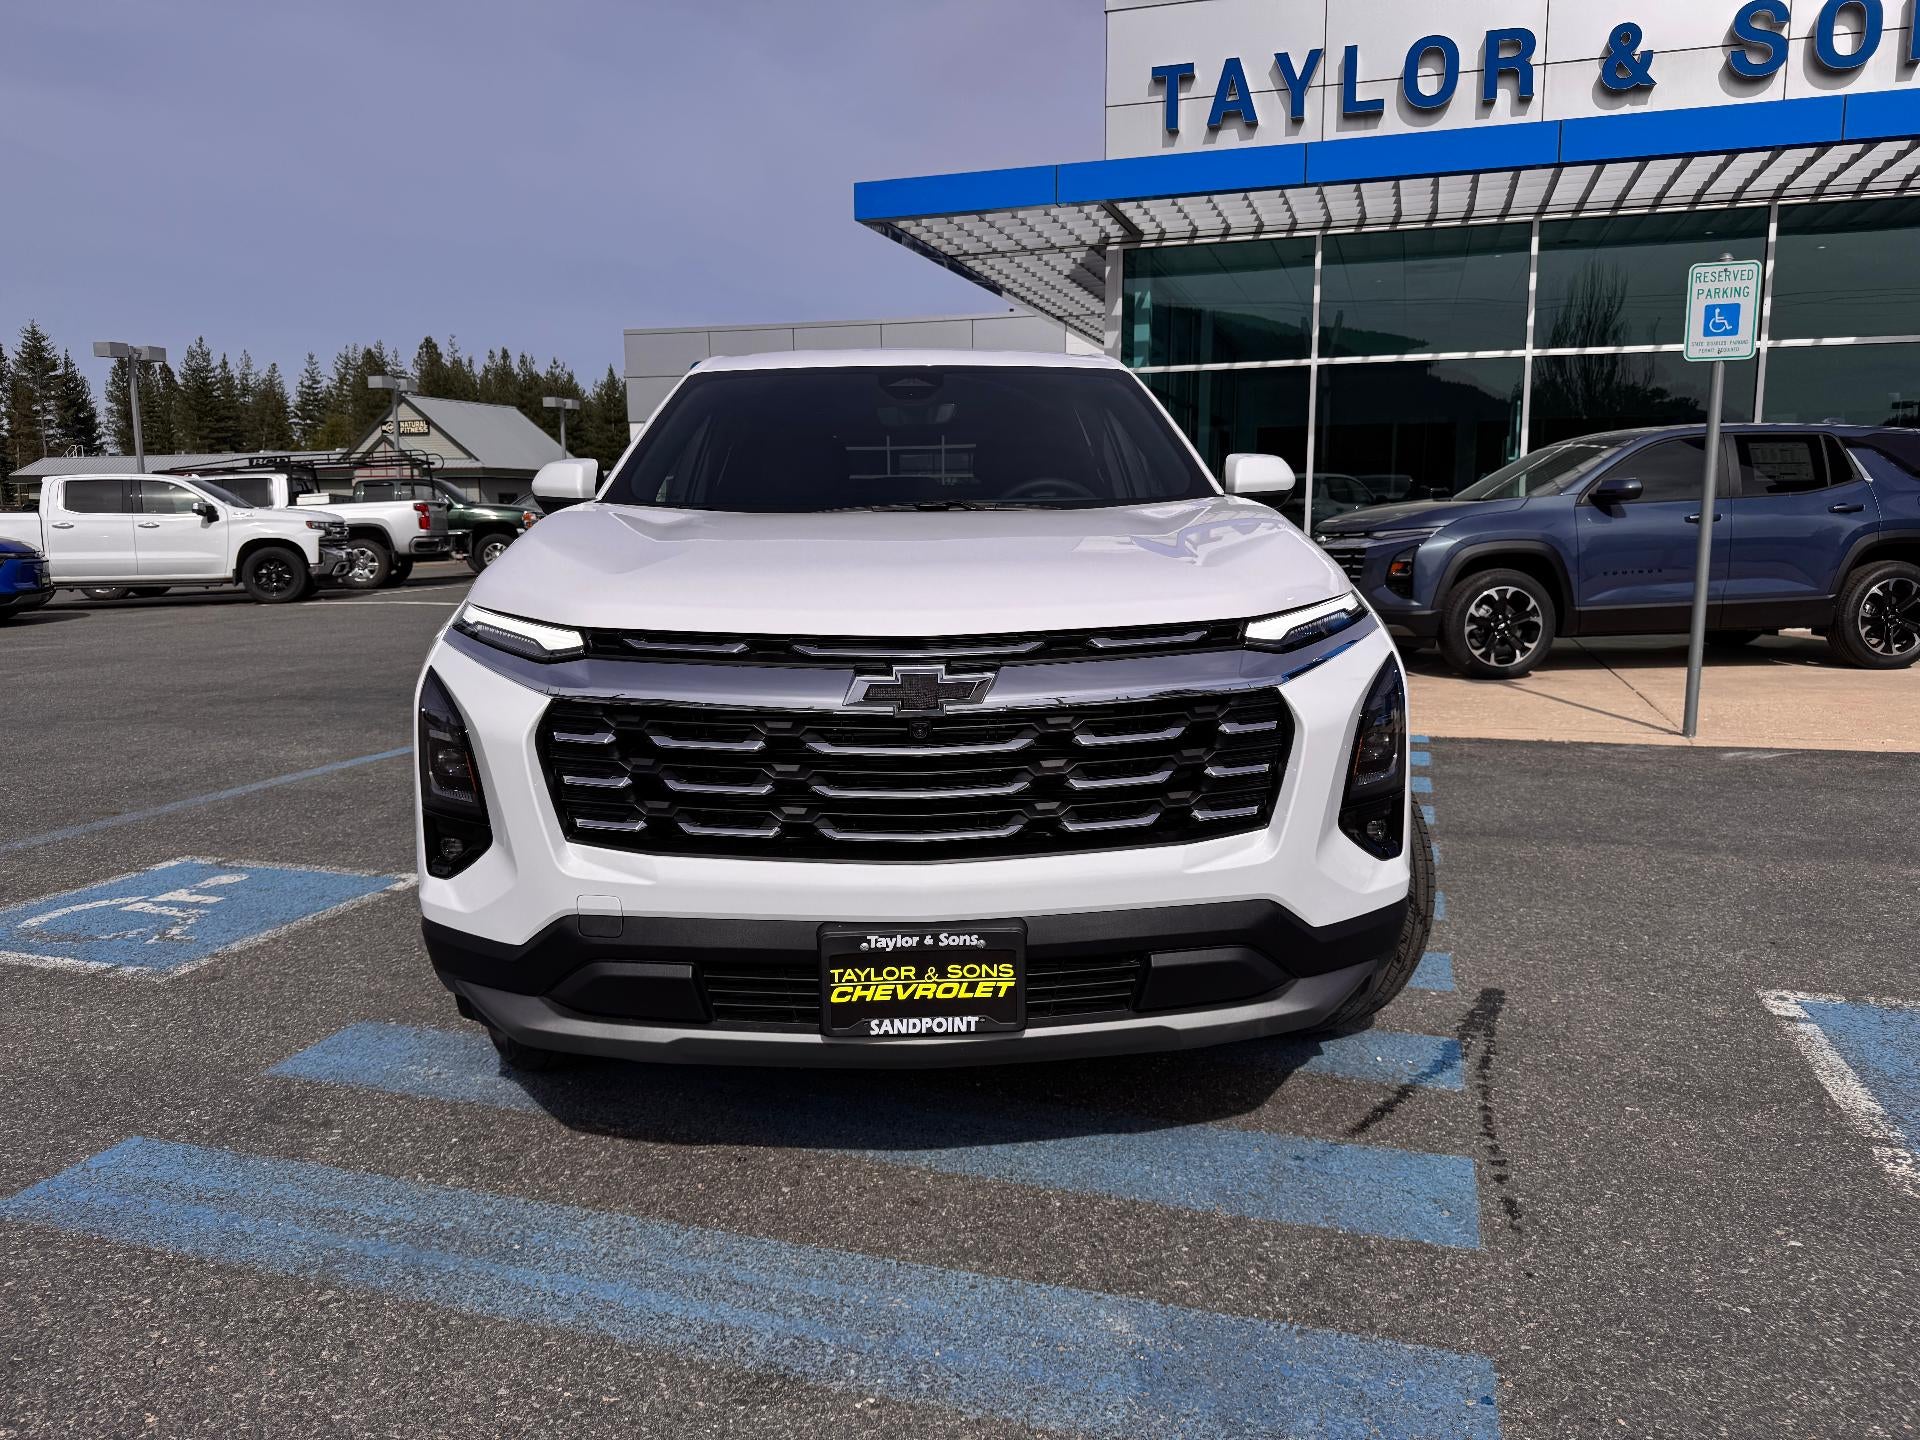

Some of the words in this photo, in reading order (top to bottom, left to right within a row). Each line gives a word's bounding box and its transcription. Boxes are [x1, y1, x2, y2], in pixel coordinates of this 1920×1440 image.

[1151, 27, 1537, 133] TAYLOR
[1602, 22, 1657, 91] &
[1730, 0, 1920, 77] SO
[1695, 269, 1754, 283] RESERVED
[1696, 286, 1750, 299] PARKING
[400, 425, 428, 433] FITNESS
[867, 934, 920, 951] Taylor
[924, 935, 934, 946] &
[938, 933, 978, 947] Sons
[830, 966, 916, 983] TAYLOR
[924, 967, 939, 982] &
[947, 963, 1015, 979] SONS
[830, 981, 1016, 1003] CHEVROLET
[869, 1016, 979, 1035] SANDPOINT
